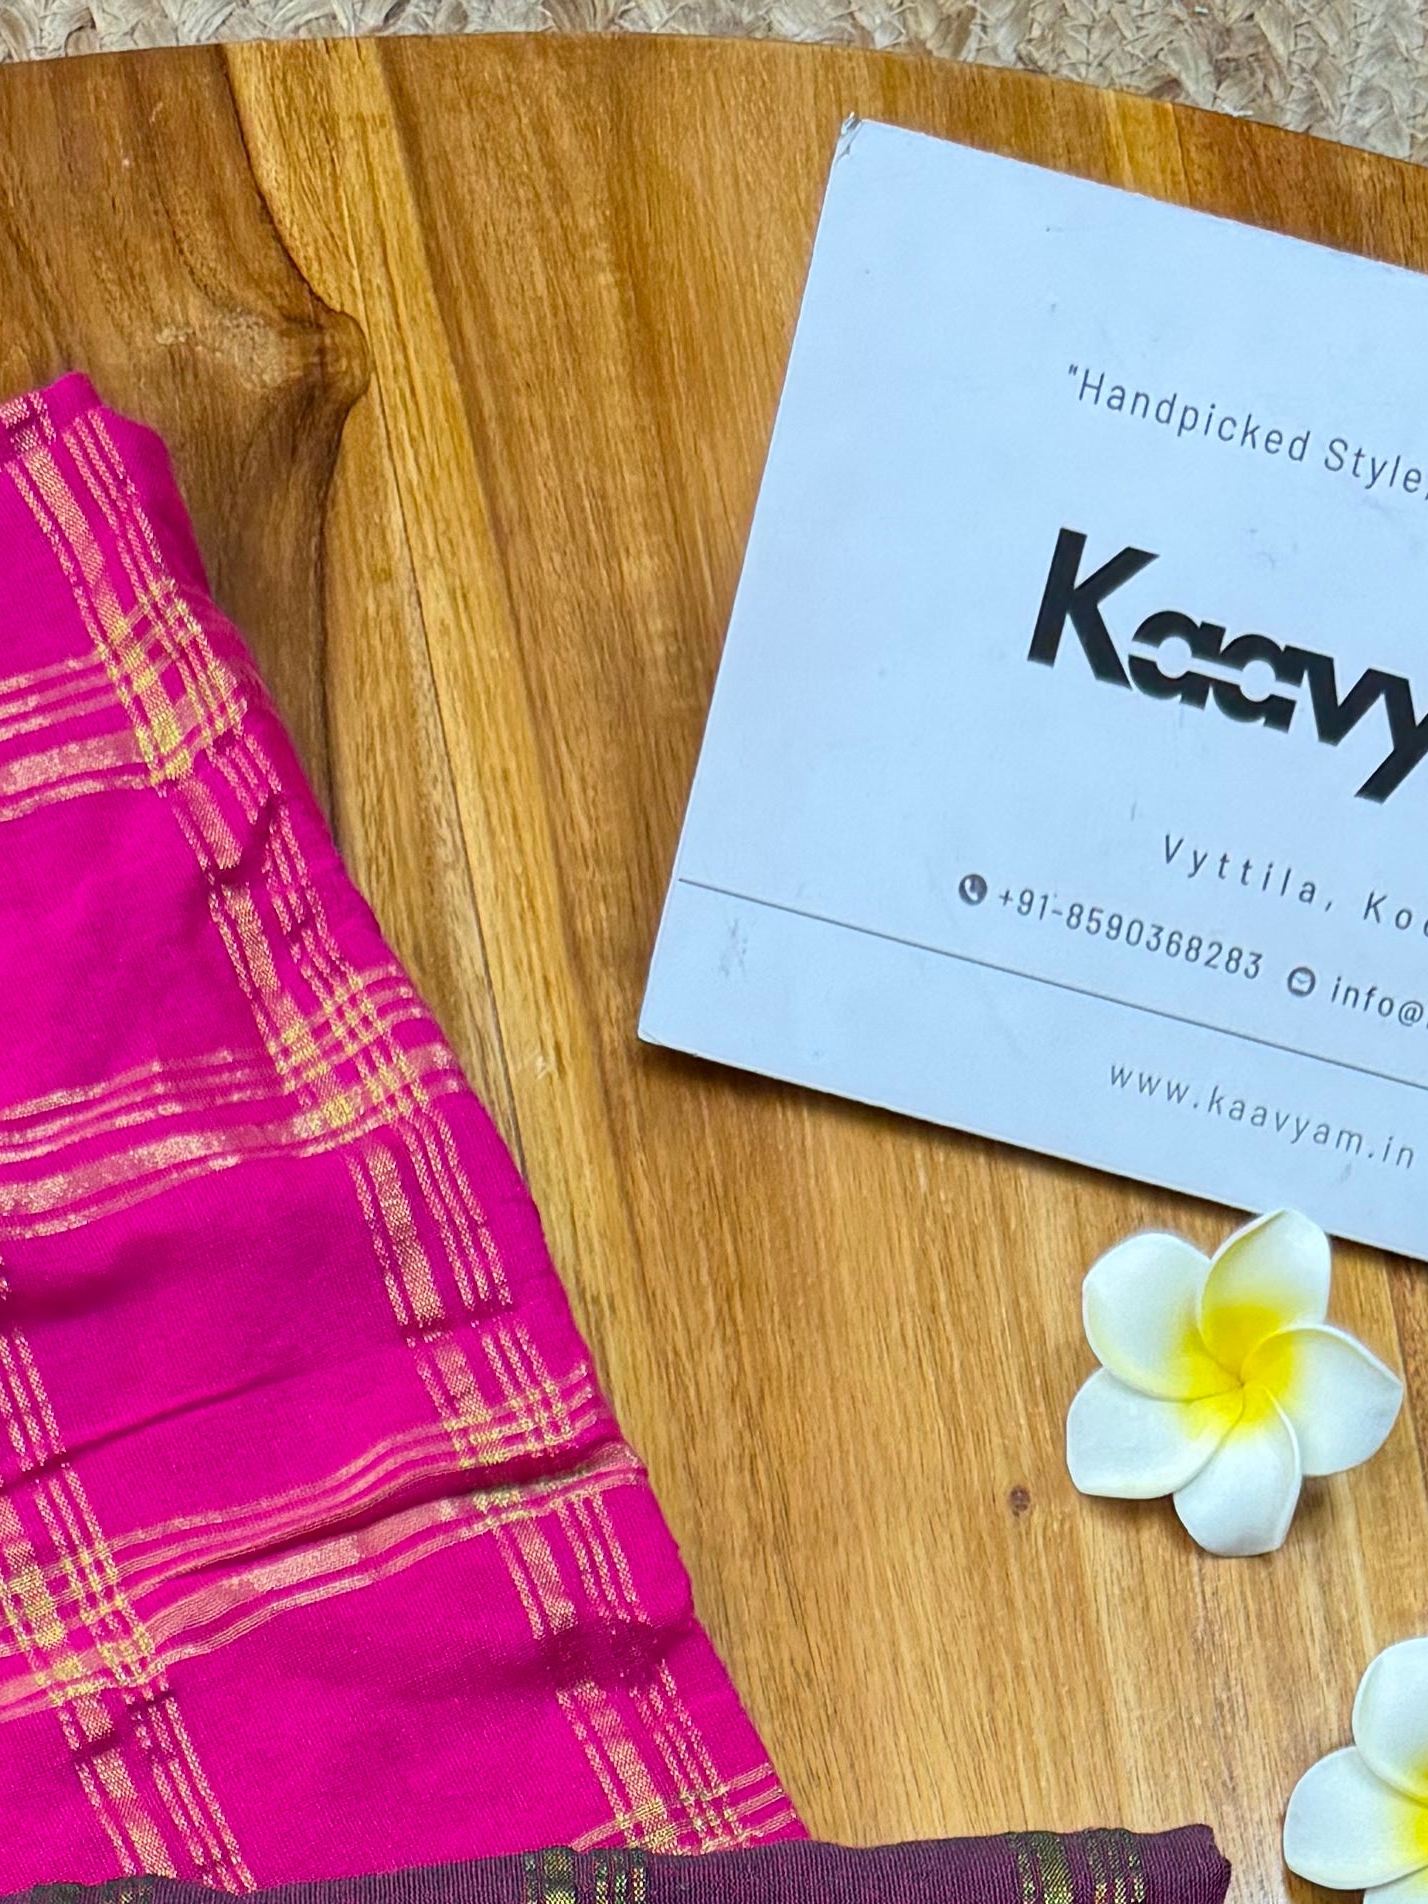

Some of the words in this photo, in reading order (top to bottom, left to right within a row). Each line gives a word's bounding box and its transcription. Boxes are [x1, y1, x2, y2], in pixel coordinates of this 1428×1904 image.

[1068, 363, 1311, 462] "Handpicked
[1163, 833, 1334, 912] Vyttila,
[998, 887, 1263, 980] +91-8590368283
[1110, 1064, 1414, 1169] www.kaavyam.in
